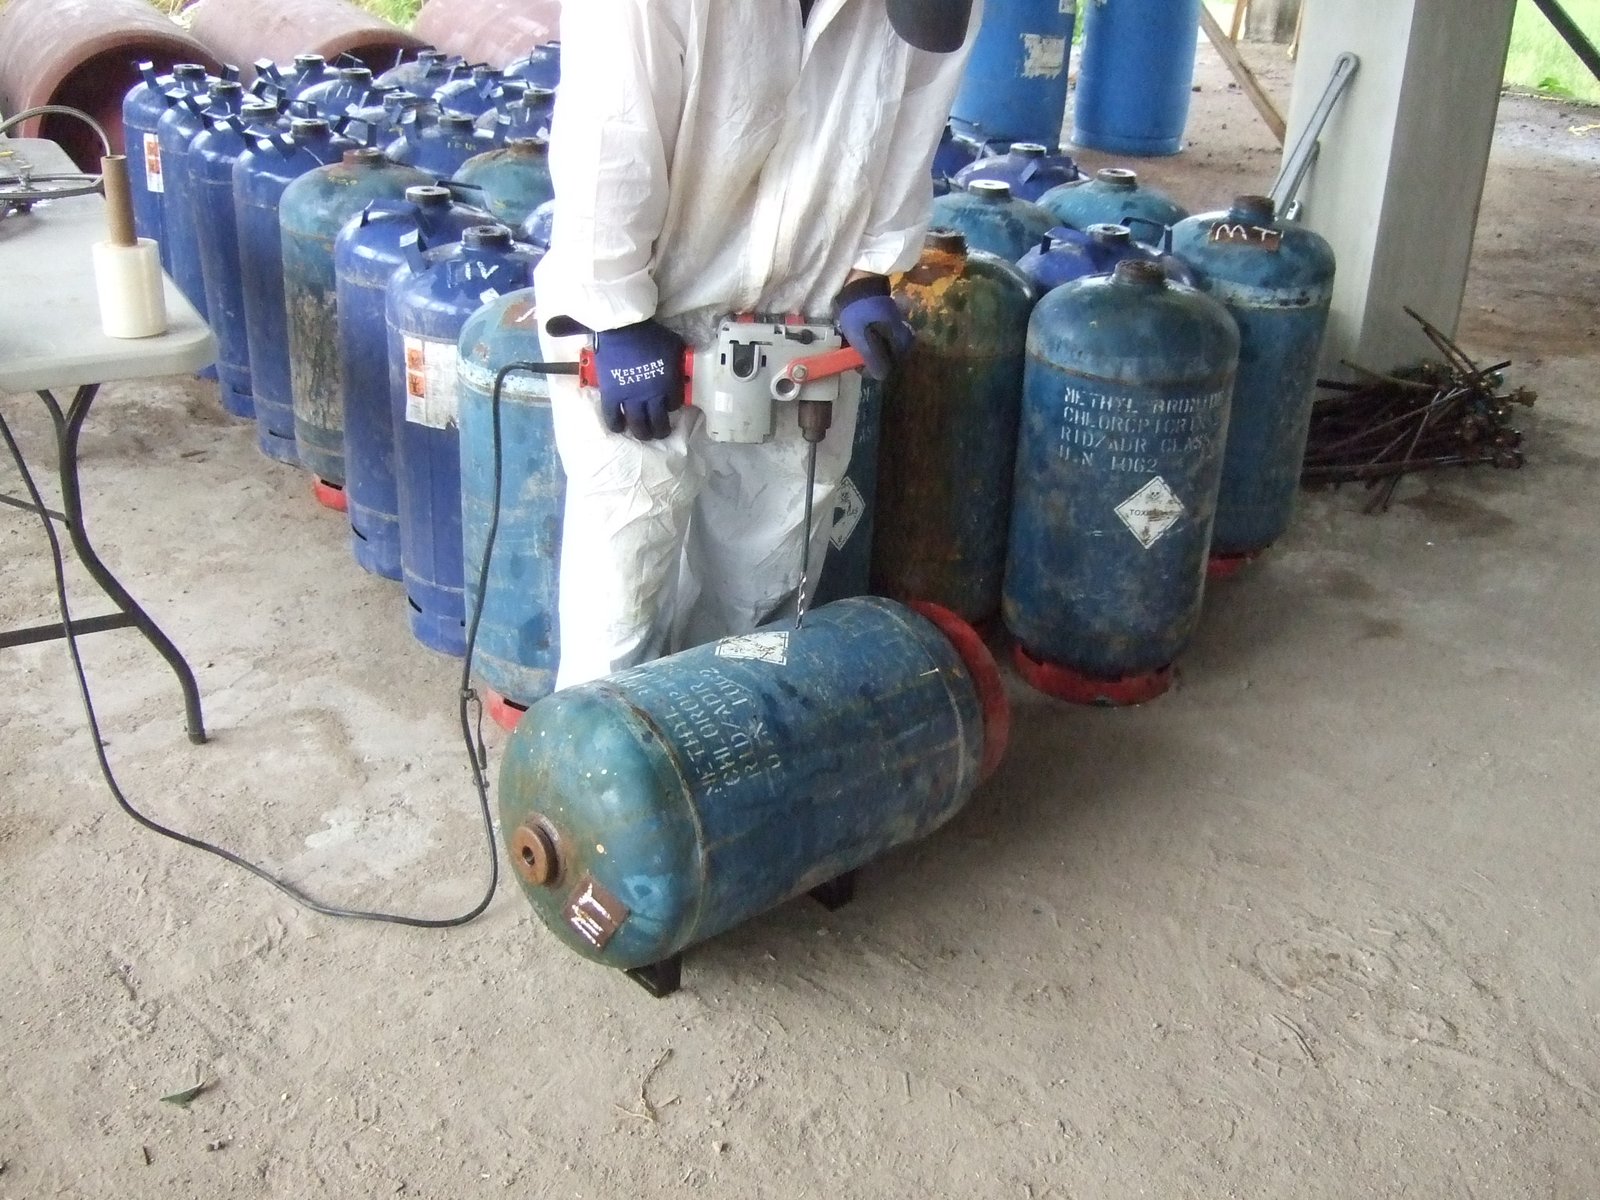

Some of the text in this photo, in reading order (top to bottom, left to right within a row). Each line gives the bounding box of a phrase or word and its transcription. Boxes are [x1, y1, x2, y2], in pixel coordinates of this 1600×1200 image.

[610, 358, 665, 379] WESTERN
[618, 367, 665, 386] SAFETY
[1064, 386, 1139, 413] METHYL
